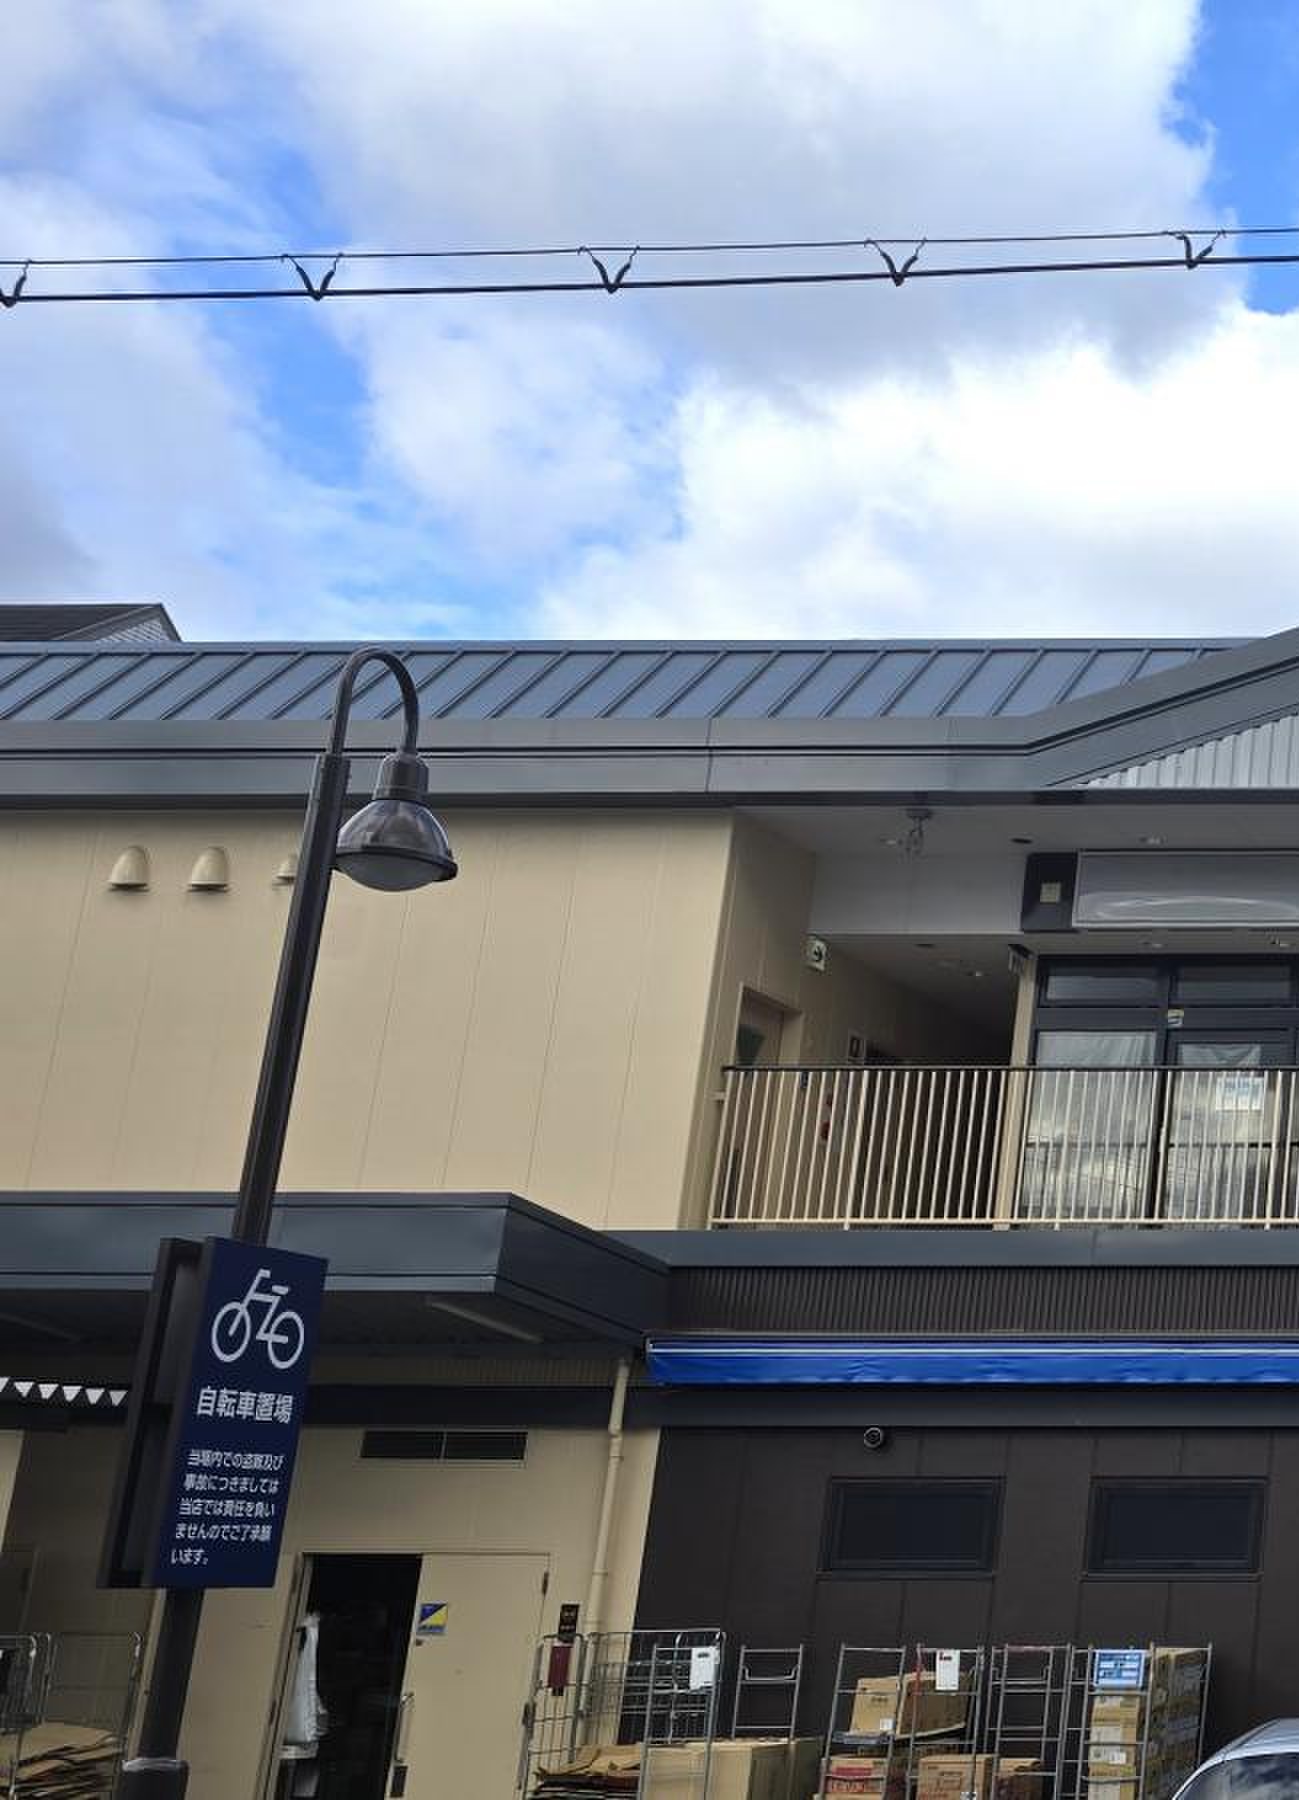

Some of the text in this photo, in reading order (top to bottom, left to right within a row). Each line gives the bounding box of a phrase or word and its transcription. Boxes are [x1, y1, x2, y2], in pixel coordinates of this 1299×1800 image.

[197, 1385, 294, 1424] 自転車置場
[183, 1473, 280, 1494] 事故につきましては
[178, 1497, 275, 1518] 当店では責任を負い
